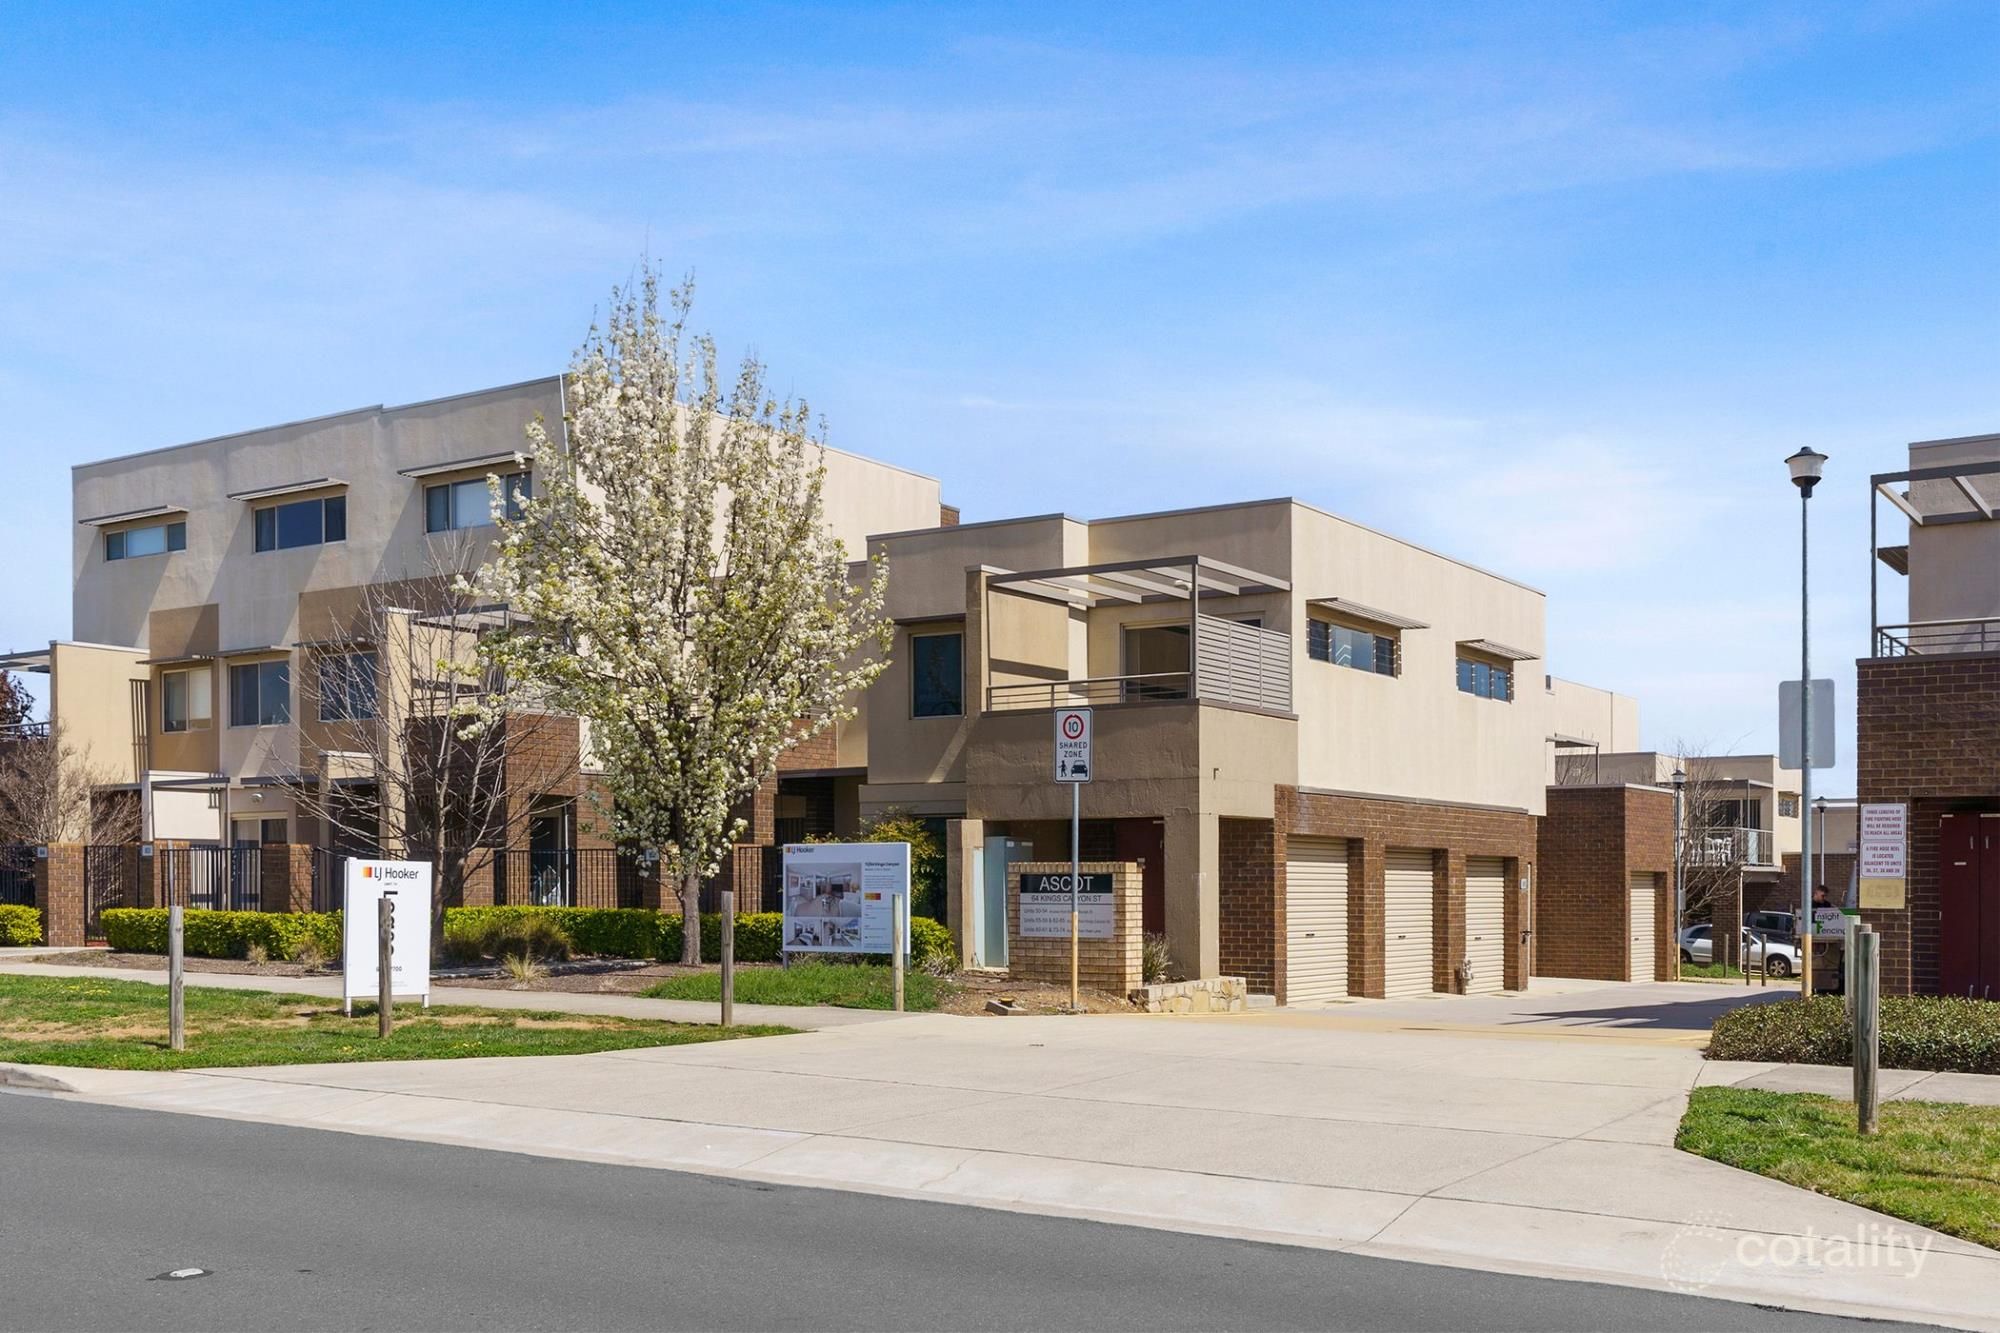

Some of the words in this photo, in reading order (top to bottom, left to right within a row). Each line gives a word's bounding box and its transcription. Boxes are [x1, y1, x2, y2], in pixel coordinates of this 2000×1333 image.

[1068, 721, 1079, 733] 10
[1059, 741, 1088, 749] SHARED
[374, 866, 382, 881] LJ
[385, 867, 419, 879] Hooker
